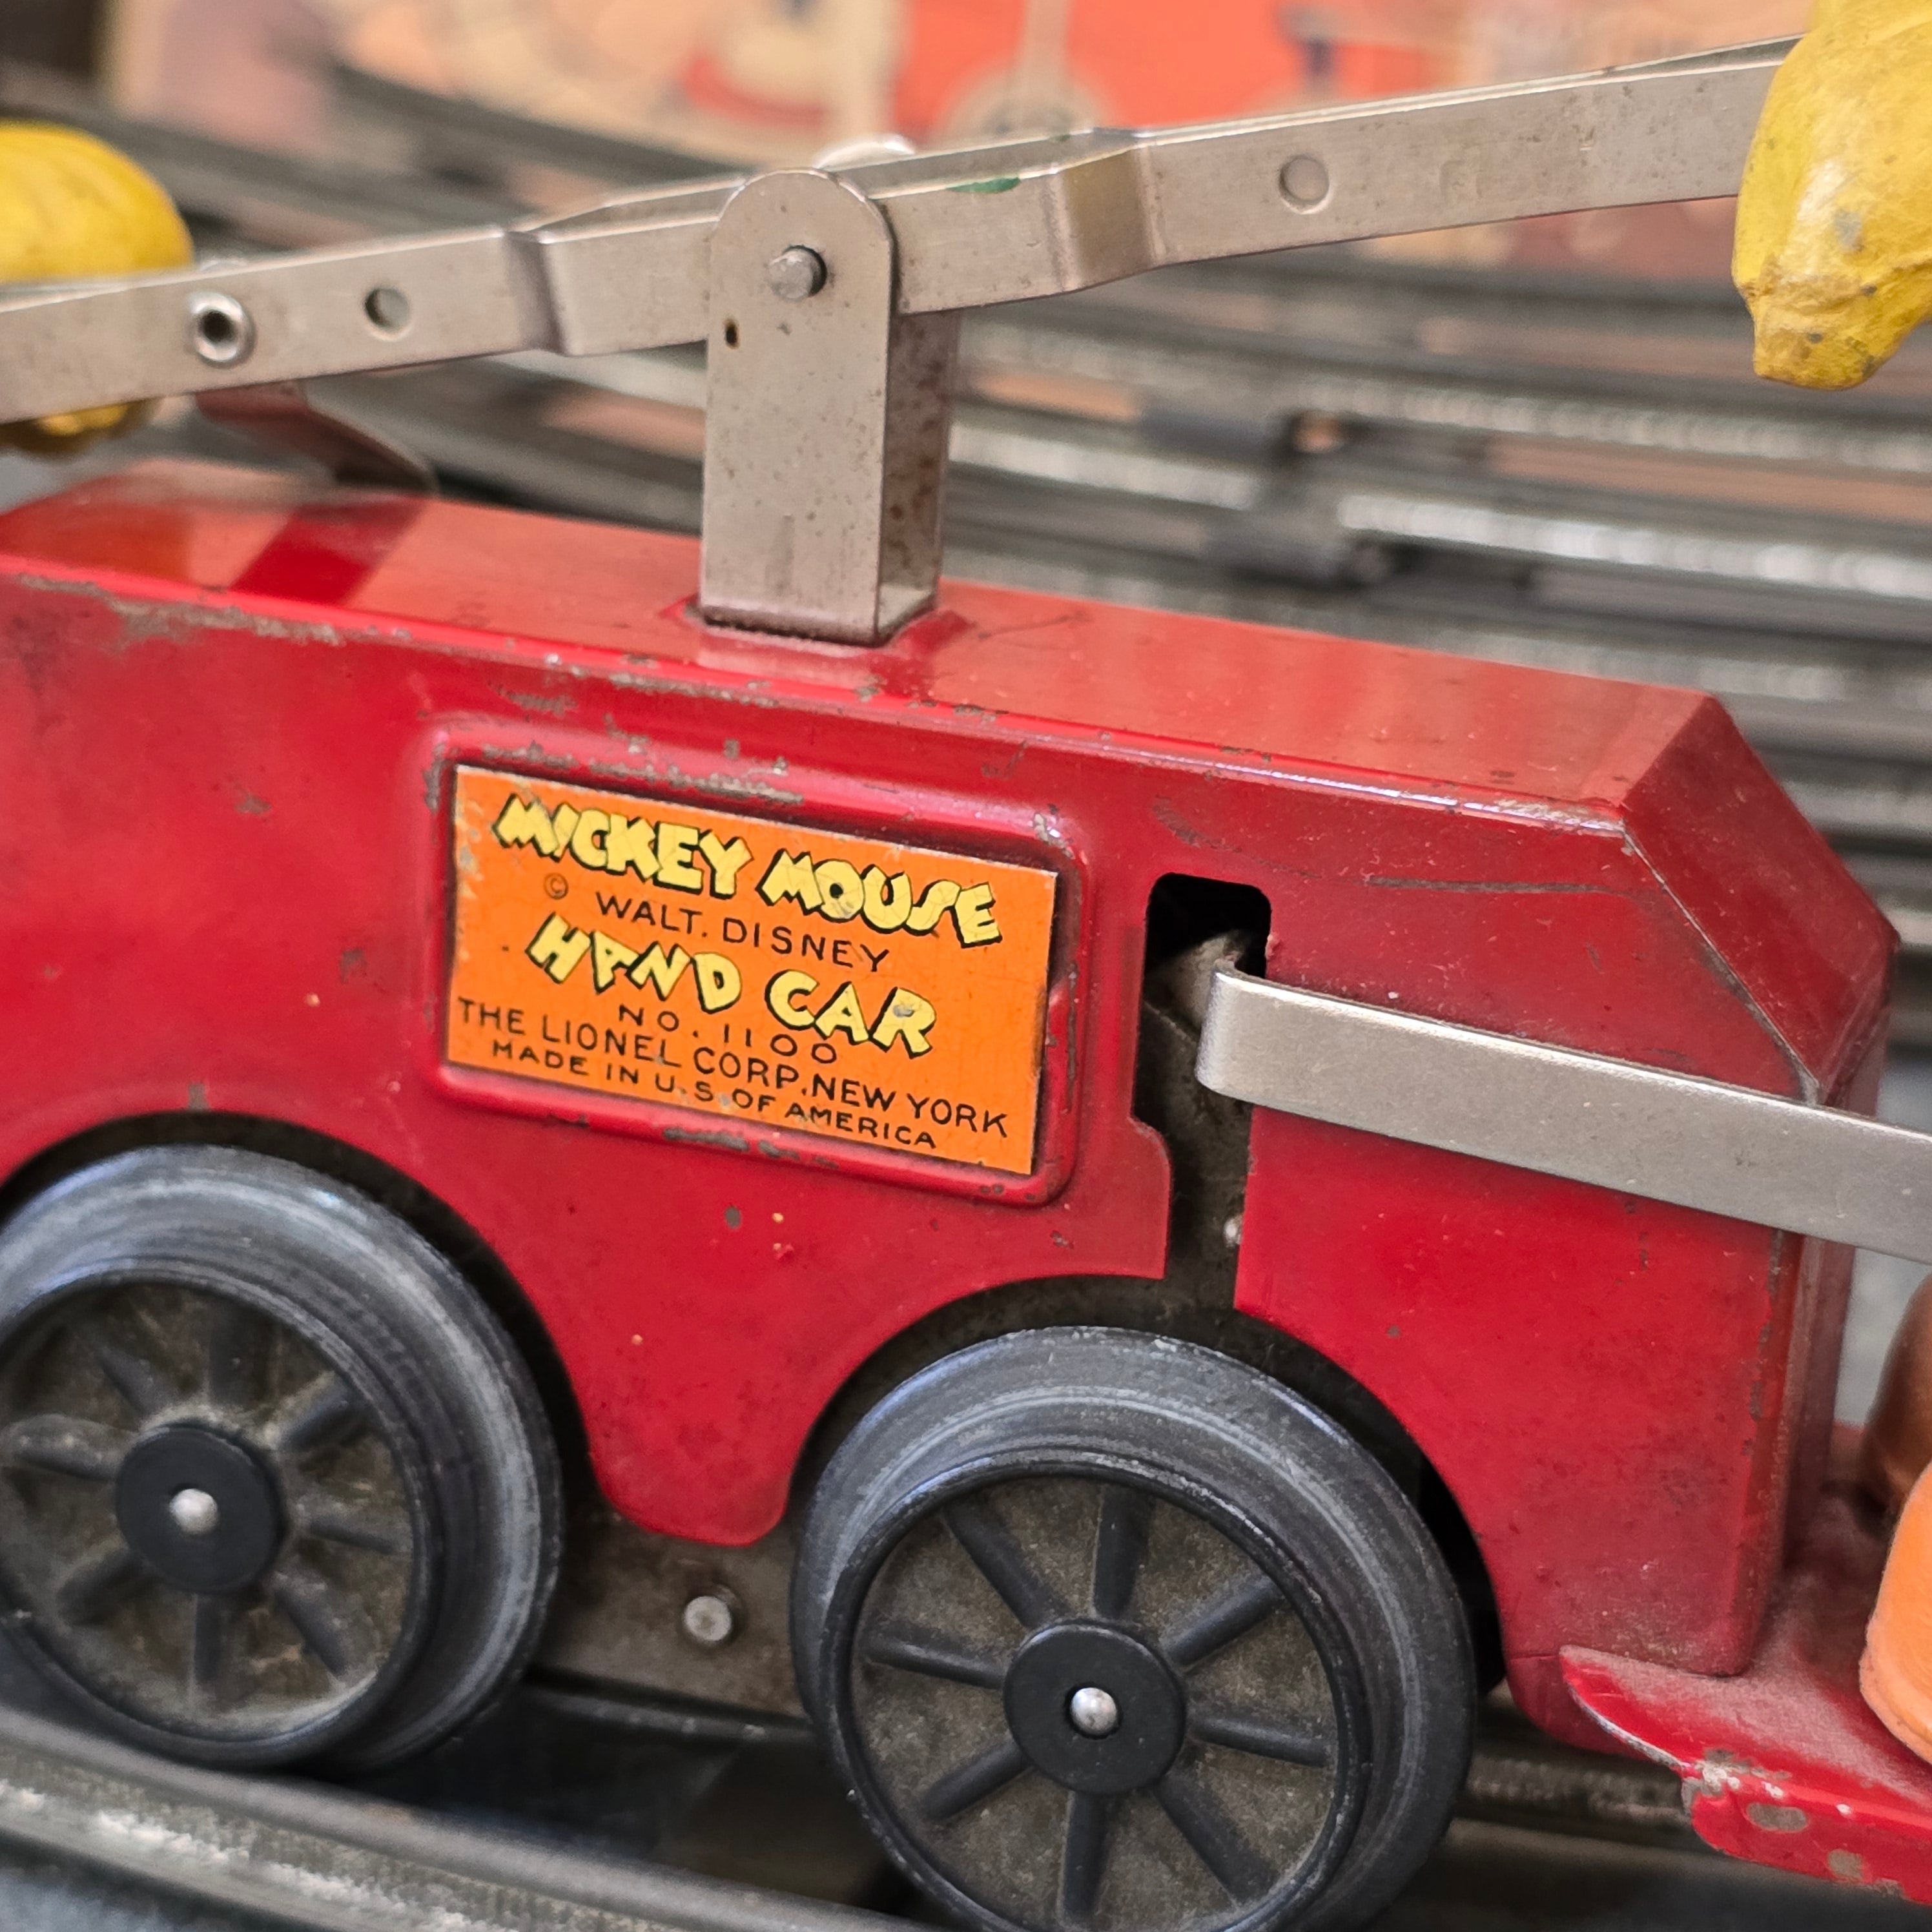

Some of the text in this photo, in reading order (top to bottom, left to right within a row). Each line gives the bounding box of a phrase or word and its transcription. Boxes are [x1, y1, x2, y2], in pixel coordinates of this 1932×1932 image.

[492, 794, 1003, 948] MICKEY MOUSE
[525, 912, 937, 1060] HAND CAR
[723, 917, 890, 972] DISNEY
[458, 997, 526, 1035] THE
[542, 1014, 682, 1068] LIONEL
[812, 1073, 896, 1111] NEW
[907, 1093, 1008, 1138] YORK
[493, 1040, 590, 1076] MADE
[606, 1064, 639, 1085] IN
[732, 1088, 776, 1112] OF
[785, 1102, 936, 1149] AMERICA
[619, 1004, 838, 1064] NO. 1100
